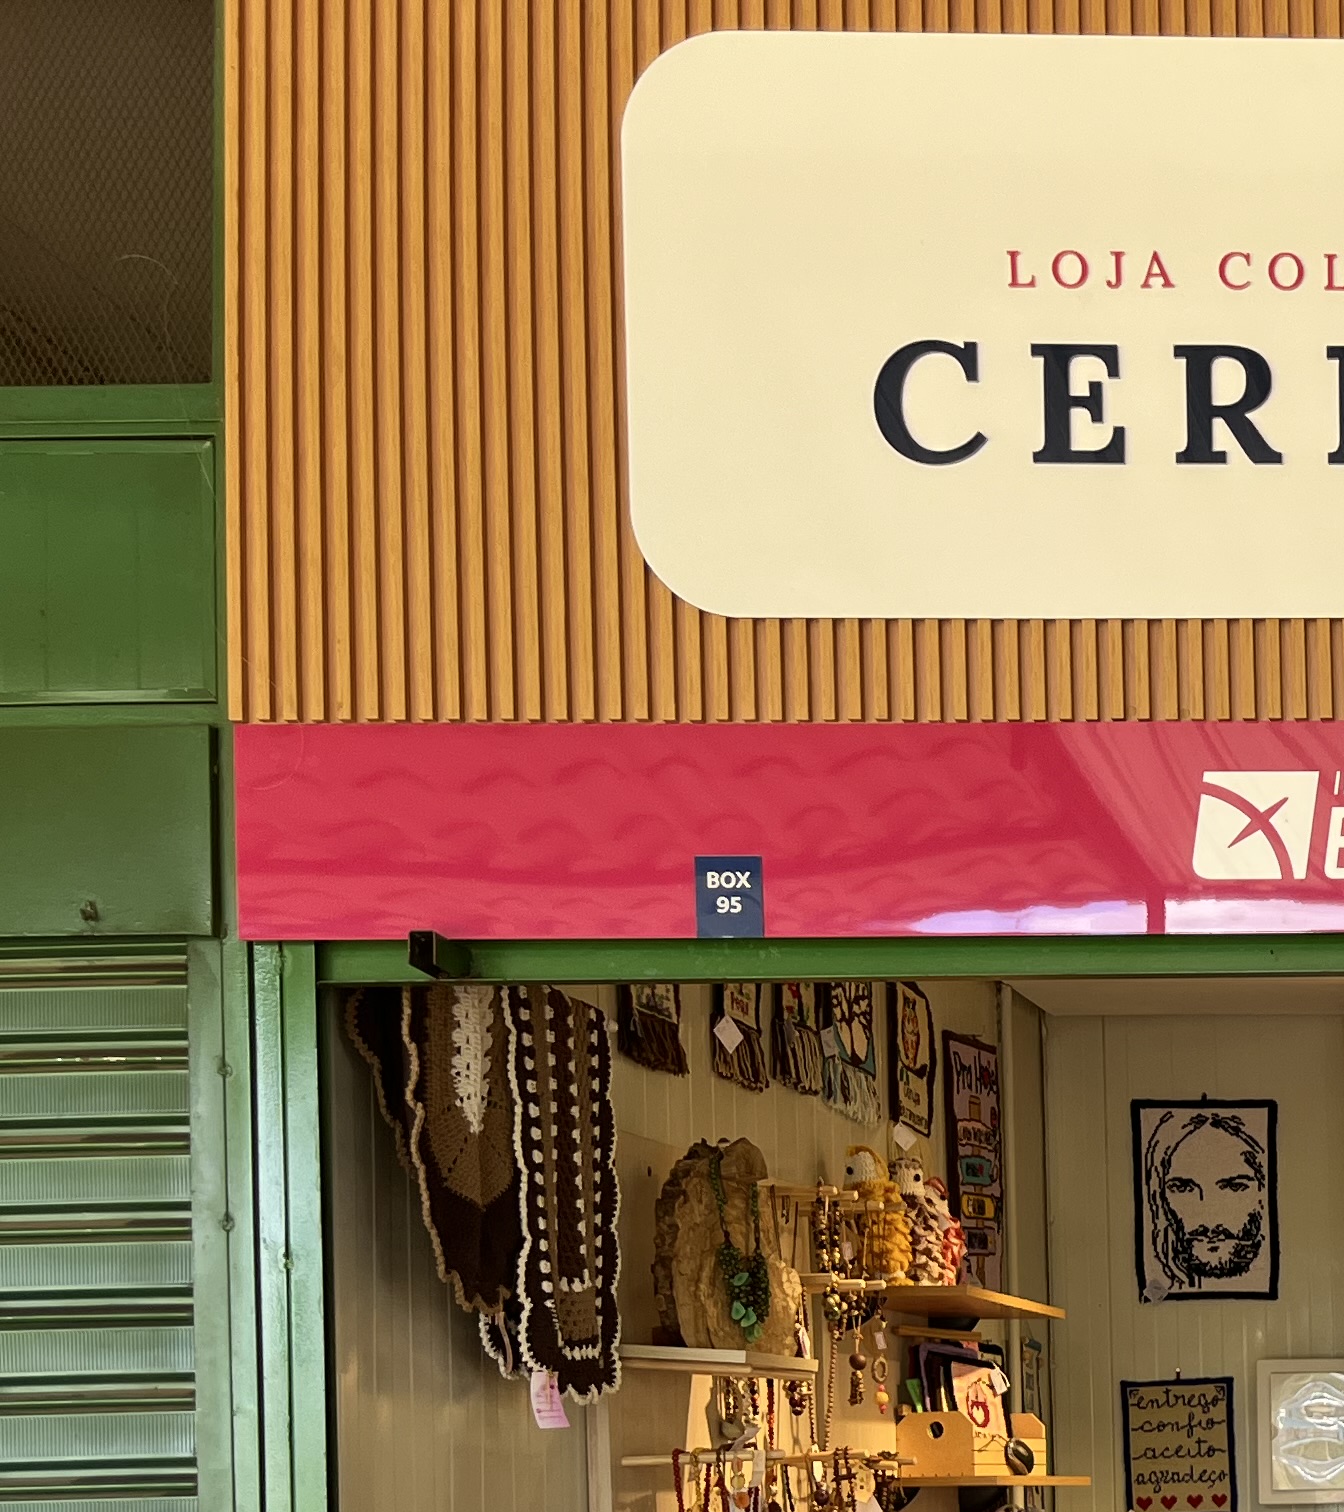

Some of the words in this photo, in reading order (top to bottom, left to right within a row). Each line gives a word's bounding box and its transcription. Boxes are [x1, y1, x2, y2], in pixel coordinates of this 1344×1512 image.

[1006, 249, 1176, 290] LOJA
[706, 871, 752, 889] BOX
[716, 896, 742, 913] 95
[1130, 1387, 1225, 1414] entrego
[1131, 1411, 1226, 1439] confio
[1132, 1437, 1226, 1460] aceito
[1134, 1464, 1228, 1494] agradeço
